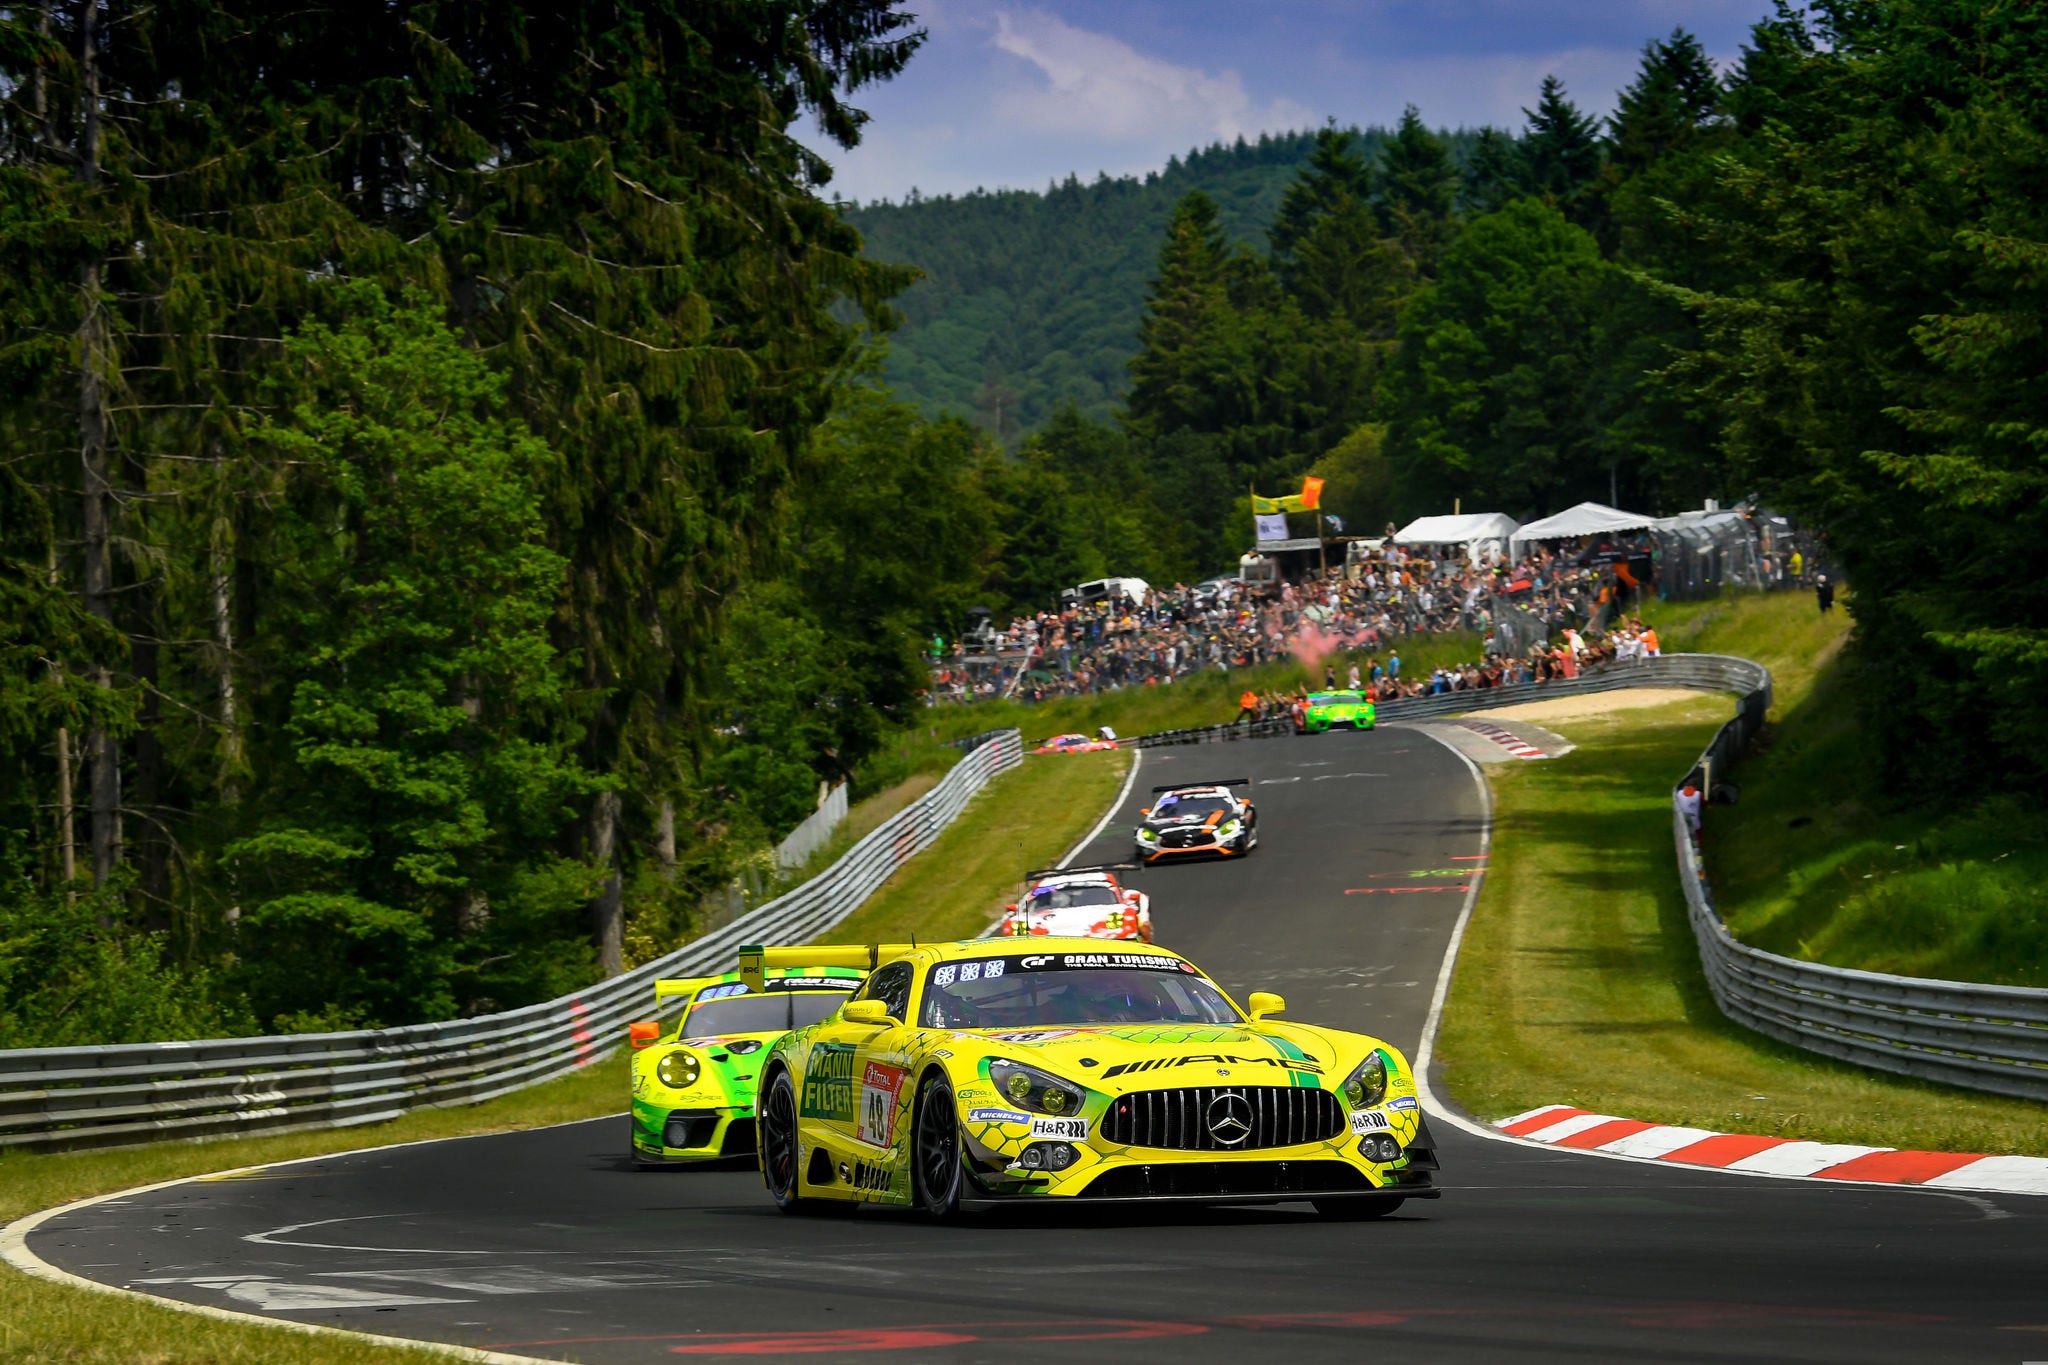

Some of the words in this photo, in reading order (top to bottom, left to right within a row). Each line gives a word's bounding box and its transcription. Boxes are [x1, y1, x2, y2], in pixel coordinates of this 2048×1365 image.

[1064, 955, 1108, 964] GRAN
[1112, 955, 1176, 967] TURISMO
[808, 1051, 853, 1079] MANN
[1175, 1055, 1325, 1075] AMG
[873, 1070, 890, 1085] TOTAL
[805, 1083, 851, 1112] FILTER
[868, 1091, 884, 1140] 48
[979, 1112, 1025, 1121] MICHELIN
[1352, 1114, 1373, 1129] H&R
[1033, 1120, 1066, 1135] H&R
